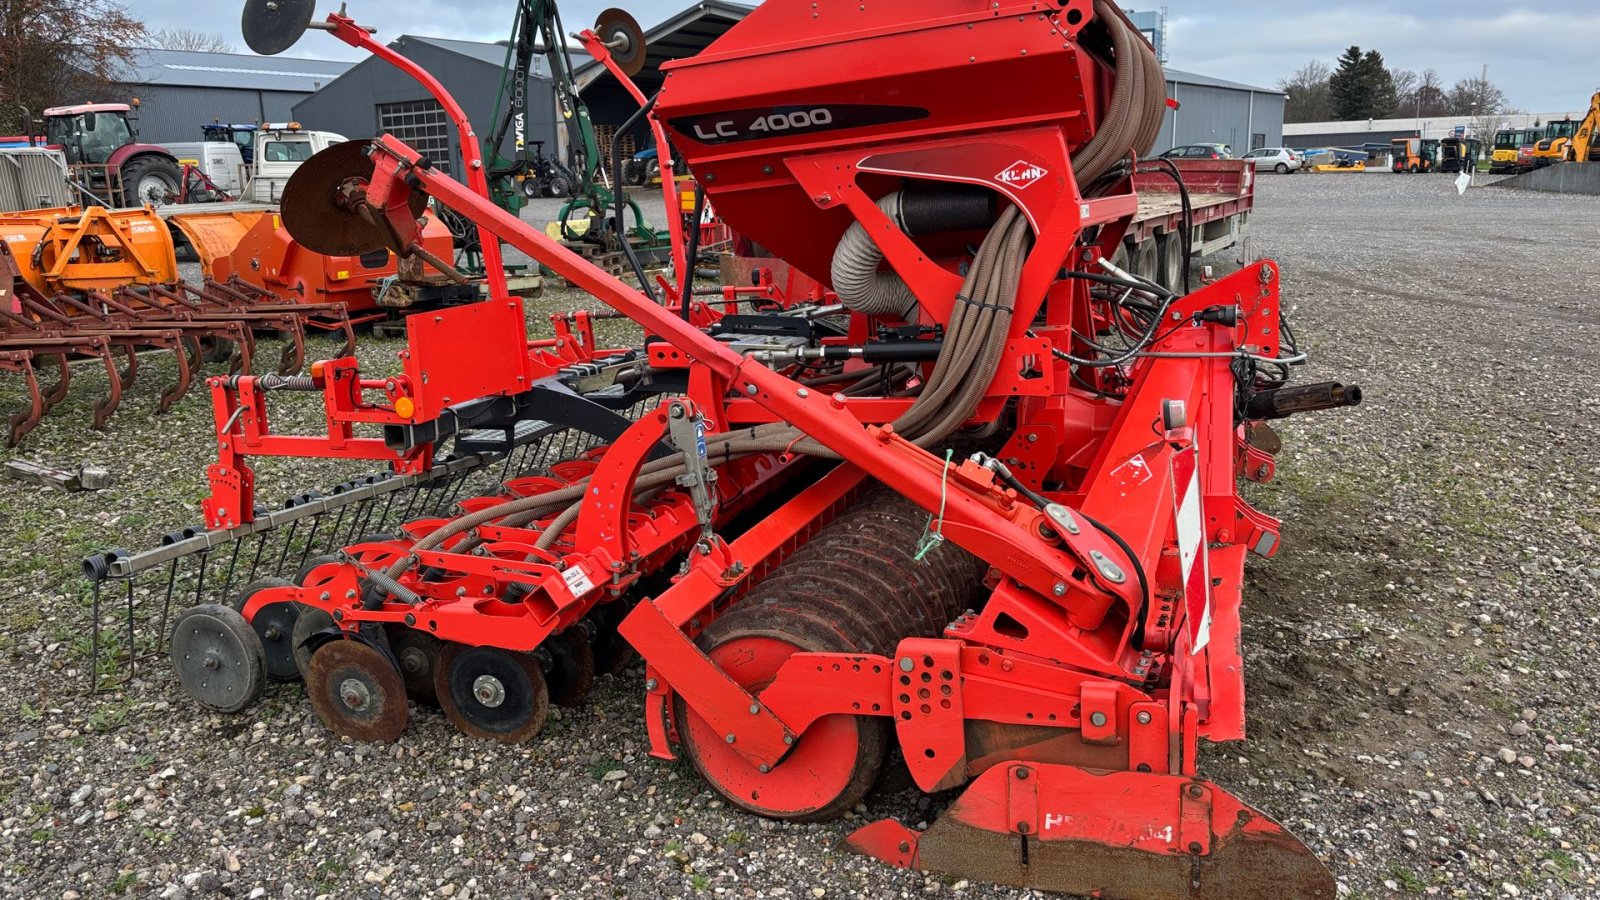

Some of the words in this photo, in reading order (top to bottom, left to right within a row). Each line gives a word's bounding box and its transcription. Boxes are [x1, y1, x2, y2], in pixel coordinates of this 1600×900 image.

[515, 113, 525, 152] TWIGA
[693, 121, 738, 139] LC
[748, 108, 832, 132] 4000
